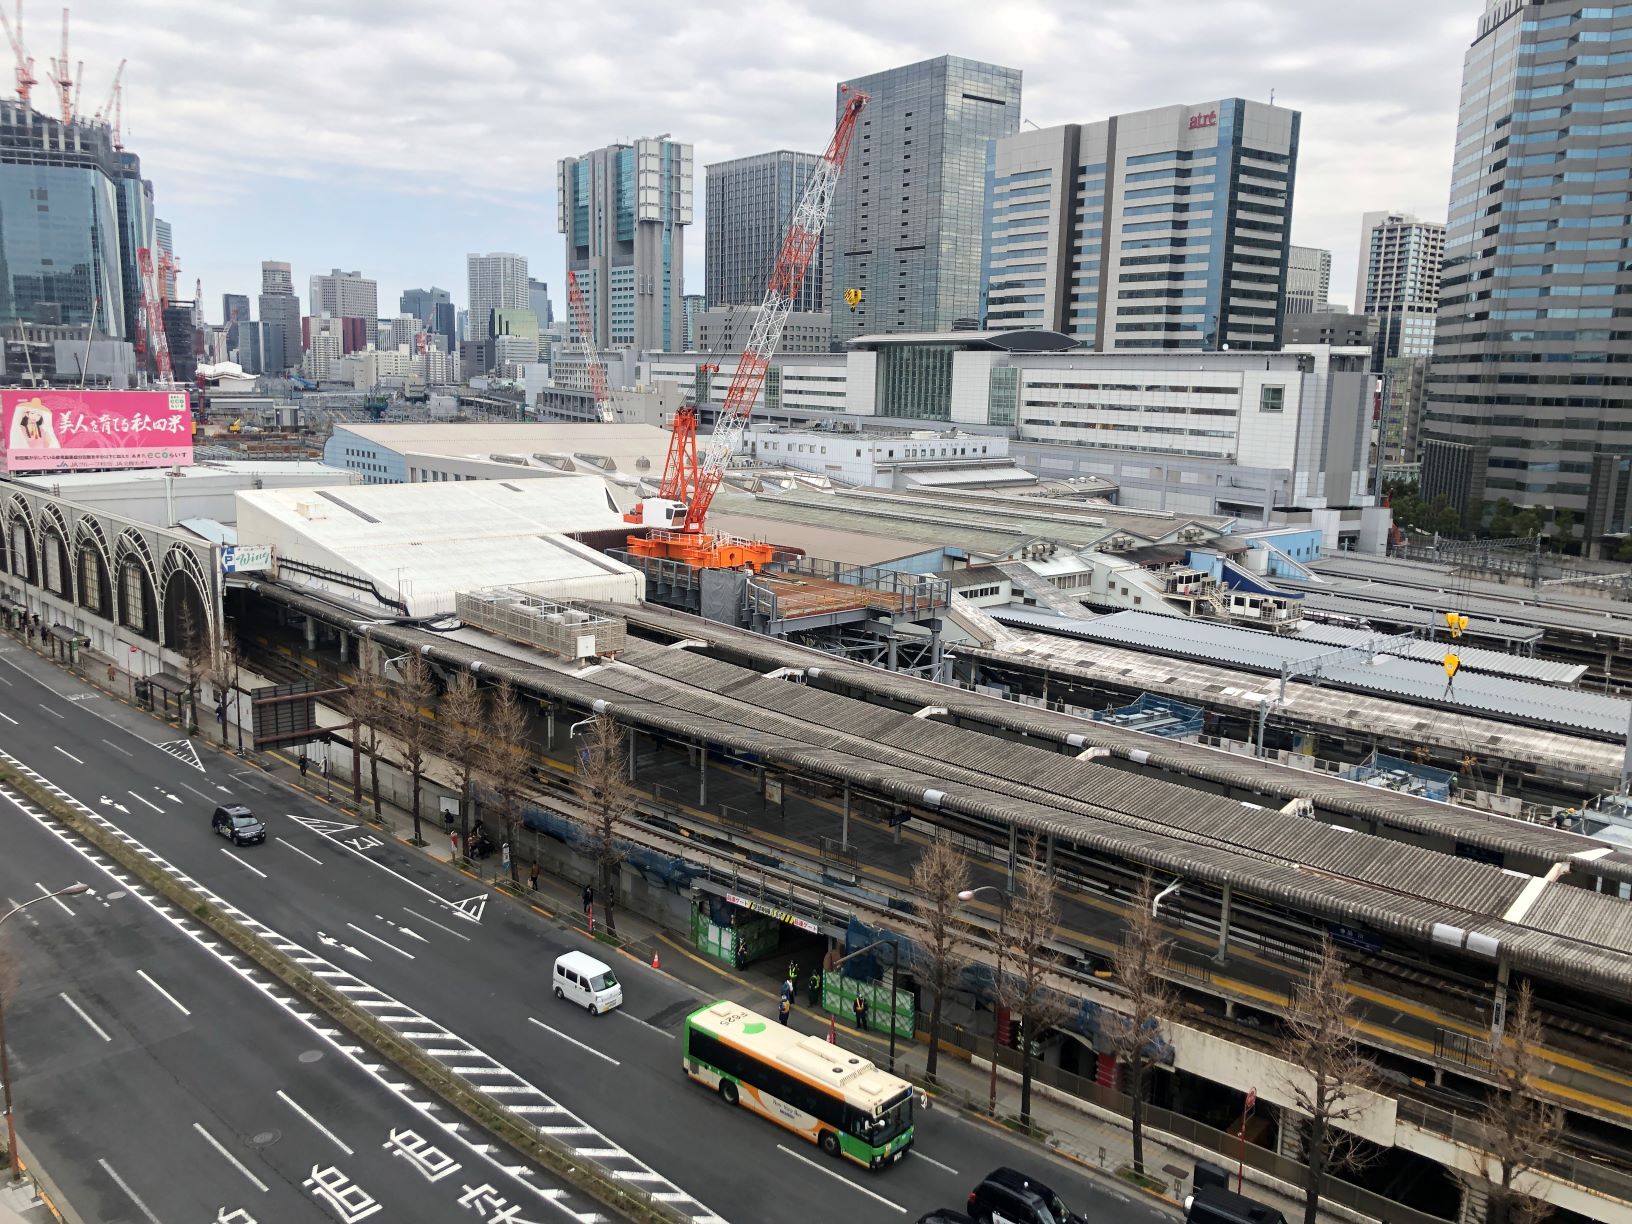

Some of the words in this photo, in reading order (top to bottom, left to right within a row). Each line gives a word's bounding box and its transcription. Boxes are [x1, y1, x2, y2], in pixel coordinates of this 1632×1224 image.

[60, 411, 185, 434] 美人を育てる秋田米
[225, 556, 233, 564] P
